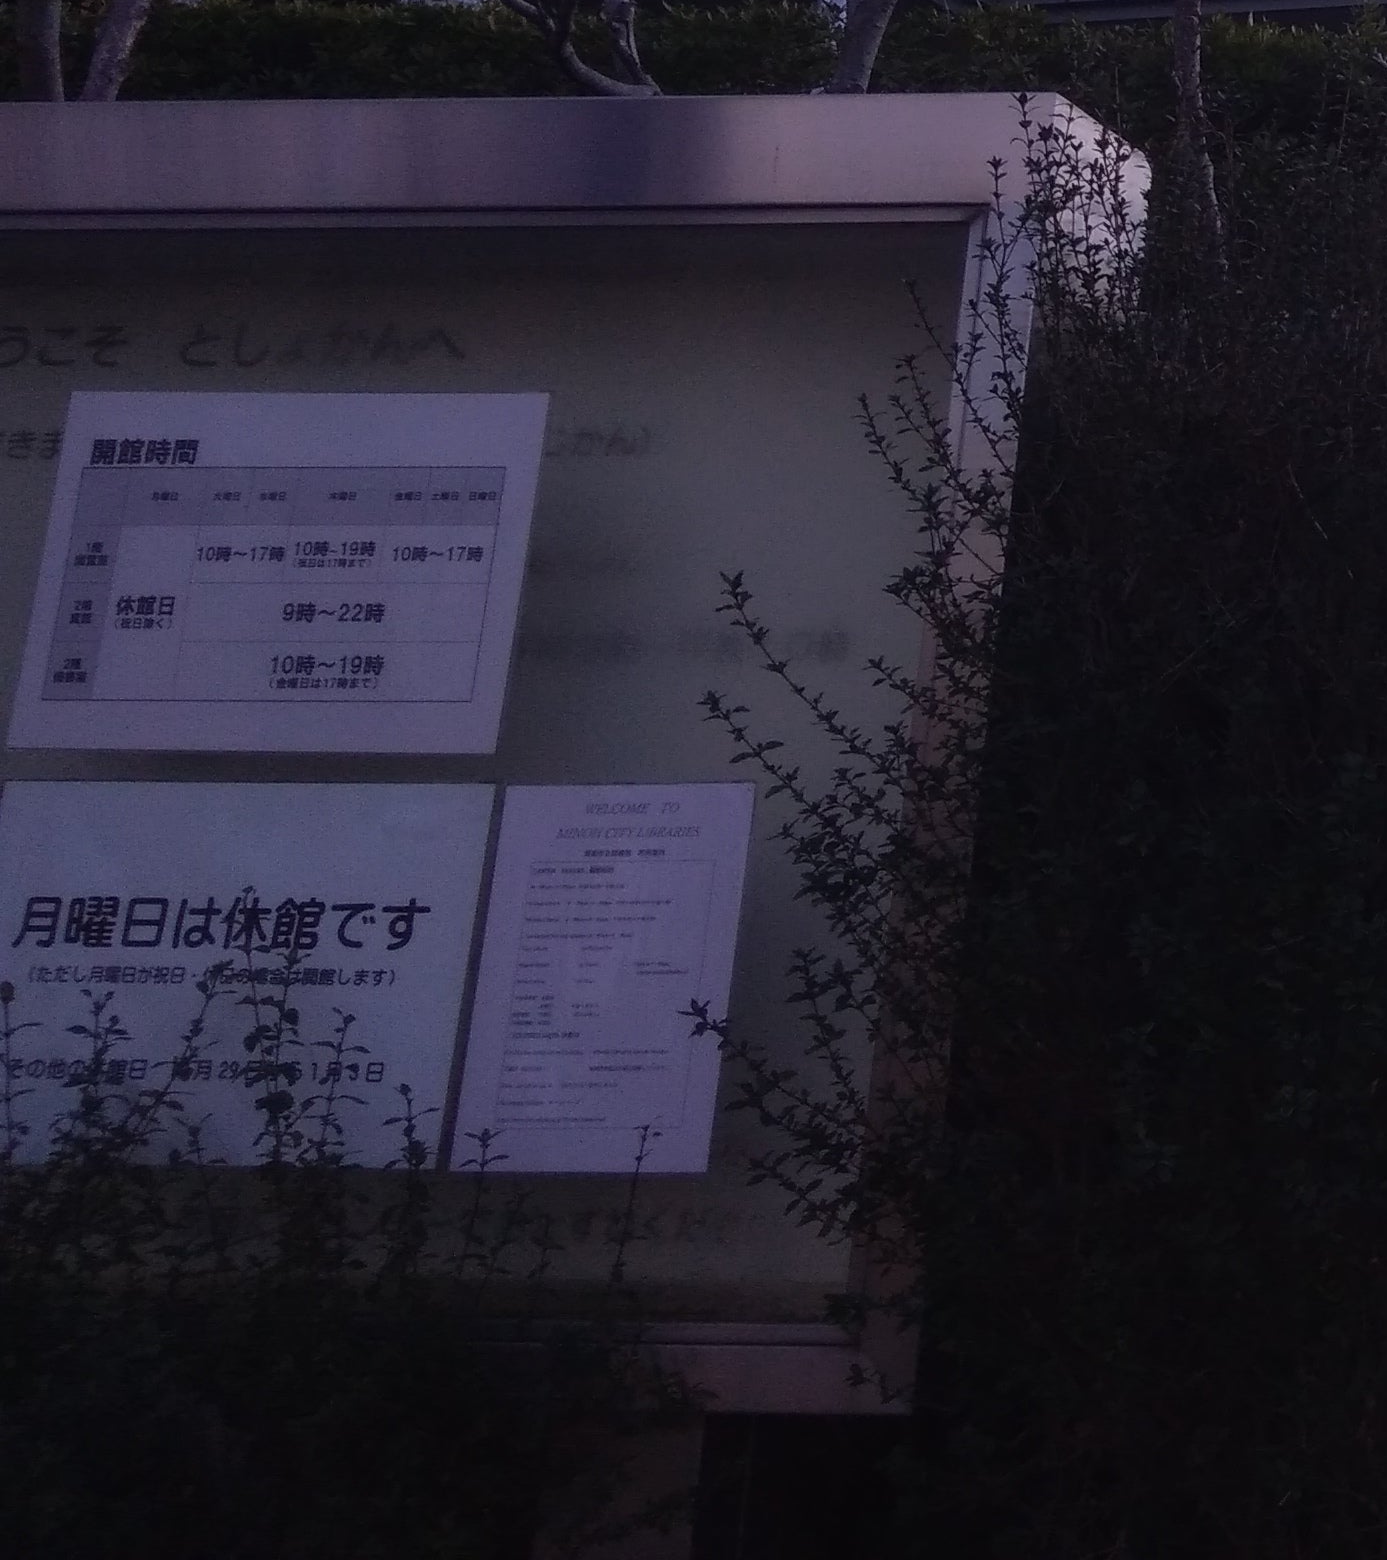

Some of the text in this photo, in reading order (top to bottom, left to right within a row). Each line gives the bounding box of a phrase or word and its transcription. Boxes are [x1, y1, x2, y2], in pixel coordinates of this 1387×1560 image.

[90, 438, 199, 465] 開館時間
[394, 491, 423, 501] 金曜日
[431, 491, 459, 501] 土曜日
[468, 491, 498, 501] 日曜日
[115, 595, 176, 616] 休館日
[12, 896, 431, 951] 月曜日は休館です
